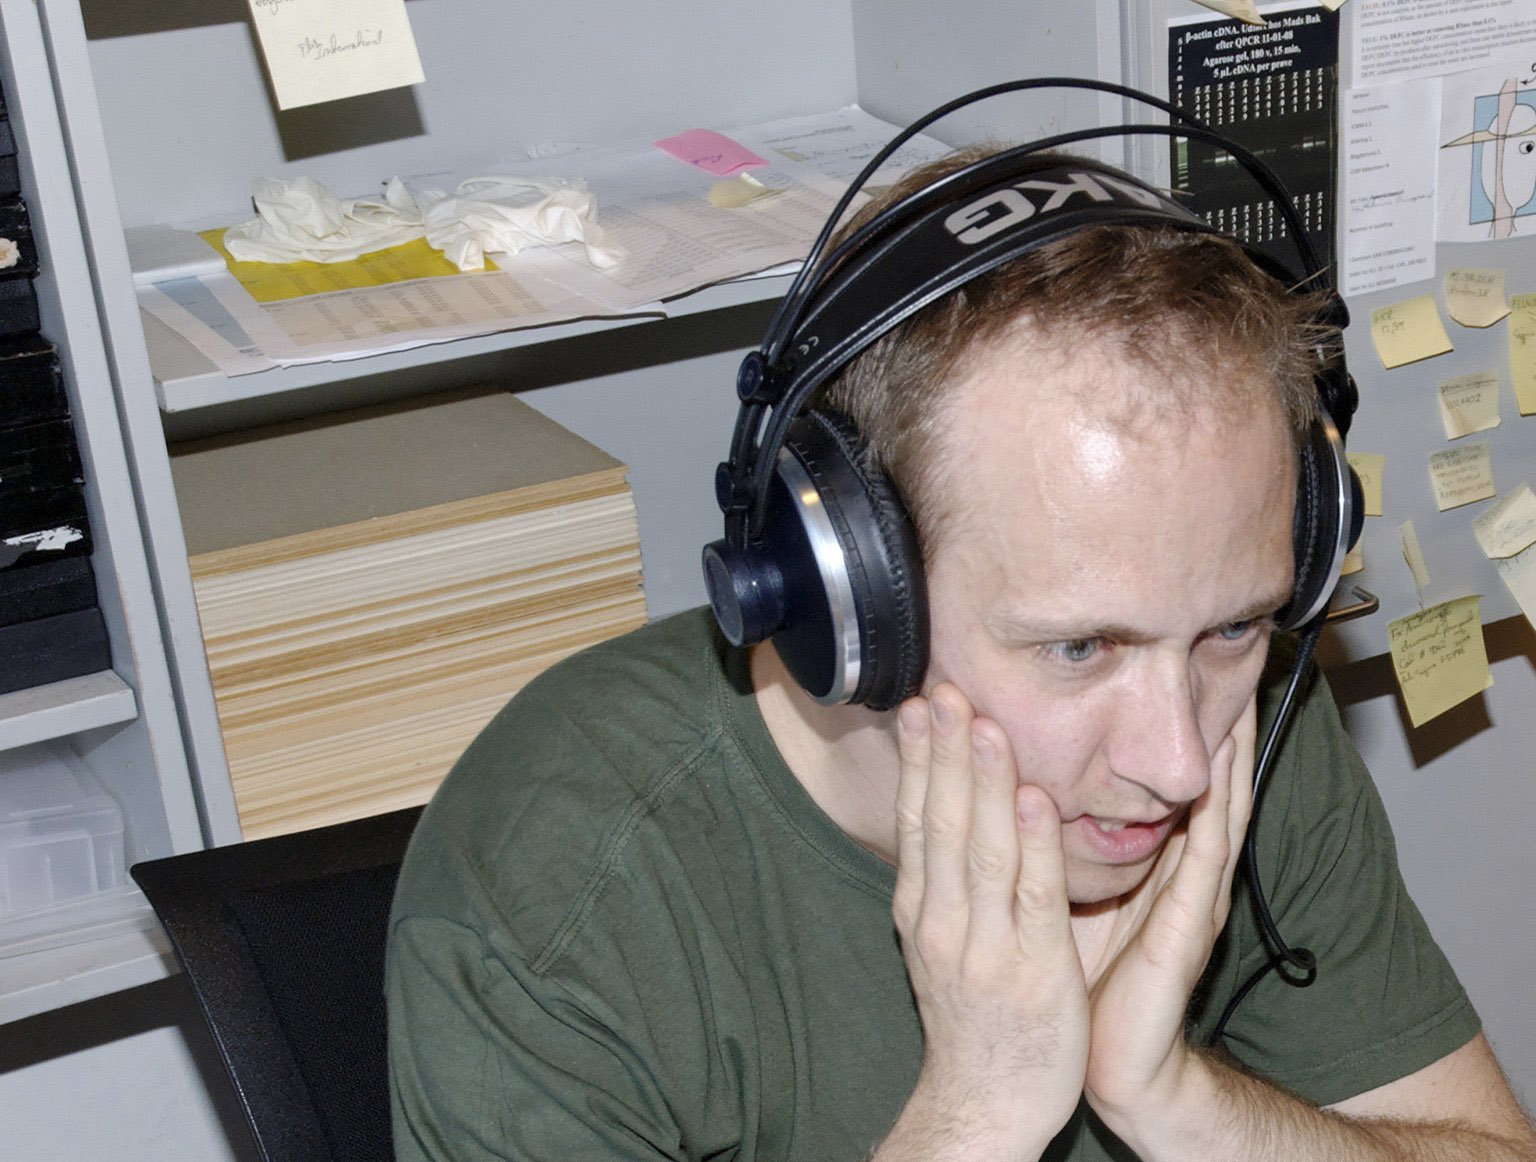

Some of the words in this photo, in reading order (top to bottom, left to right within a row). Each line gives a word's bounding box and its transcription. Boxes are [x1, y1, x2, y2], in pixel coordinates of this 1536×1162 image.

[1213, 26, 1239, 37] cDNA.
[1282, 16, 1304, 27] Mads
[1305, 13, 1321, 24] Bak
[1215, 40, 1234, 50] efter
[1234, 35, 1260, 48] QPCR
[1202, 55, 1234, 68] Agarose
[1274, 45, 1282, 55] 15
[1232, 64, 1256, 75] cDNA
[1256, 62, 1270, 73] per
[944, 173, 1162, 245] AKG
